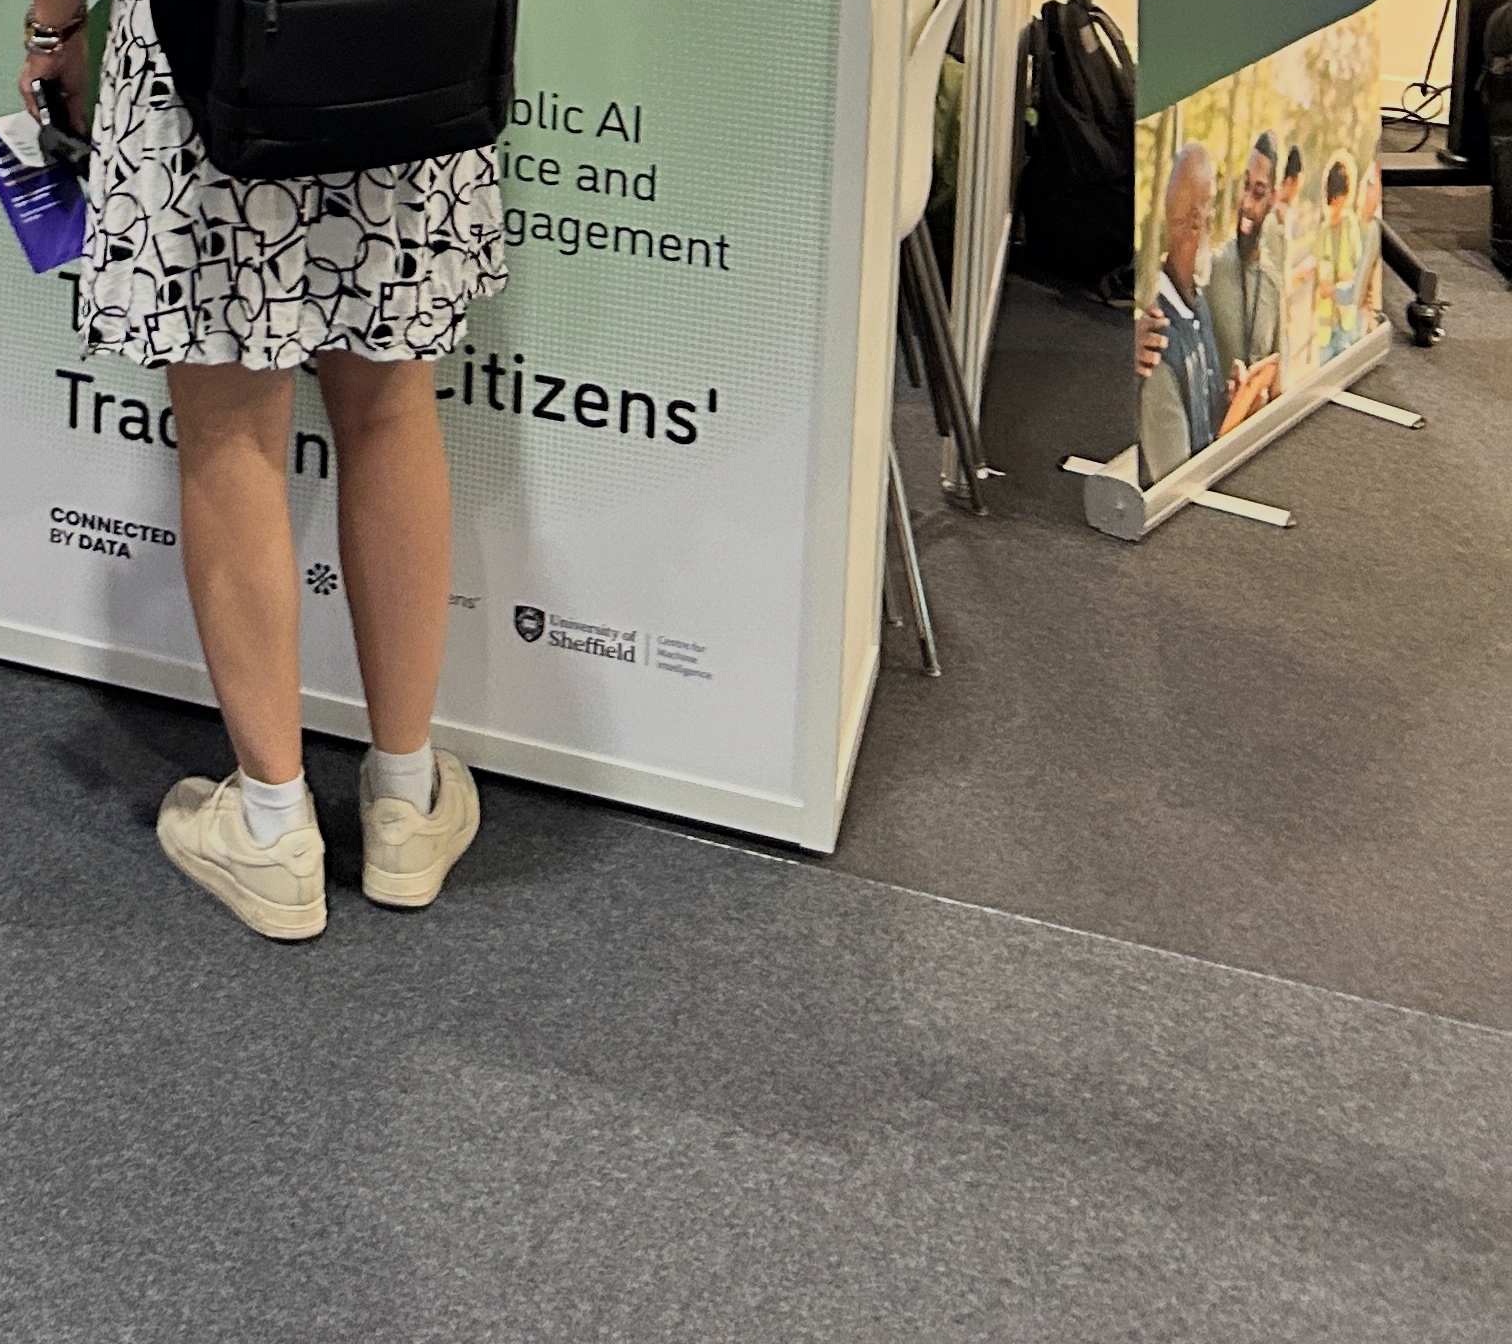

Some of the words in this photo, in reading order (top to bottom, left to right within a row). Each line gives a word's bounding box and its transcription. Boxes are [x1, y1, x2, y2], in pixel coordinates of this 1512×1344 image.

[595, 101, 643, 144] AI
[577, 164, 657, 202] and
[503, 208, 731, 271] gagement
[436, 344, 717, 445] itizens'
[49, 528, 75, 547] BY
[78, 534, 133, 560] DATA
[50, 507, 177, 547] CONNECTED
[546, 630, 638, 664] Sheffield
